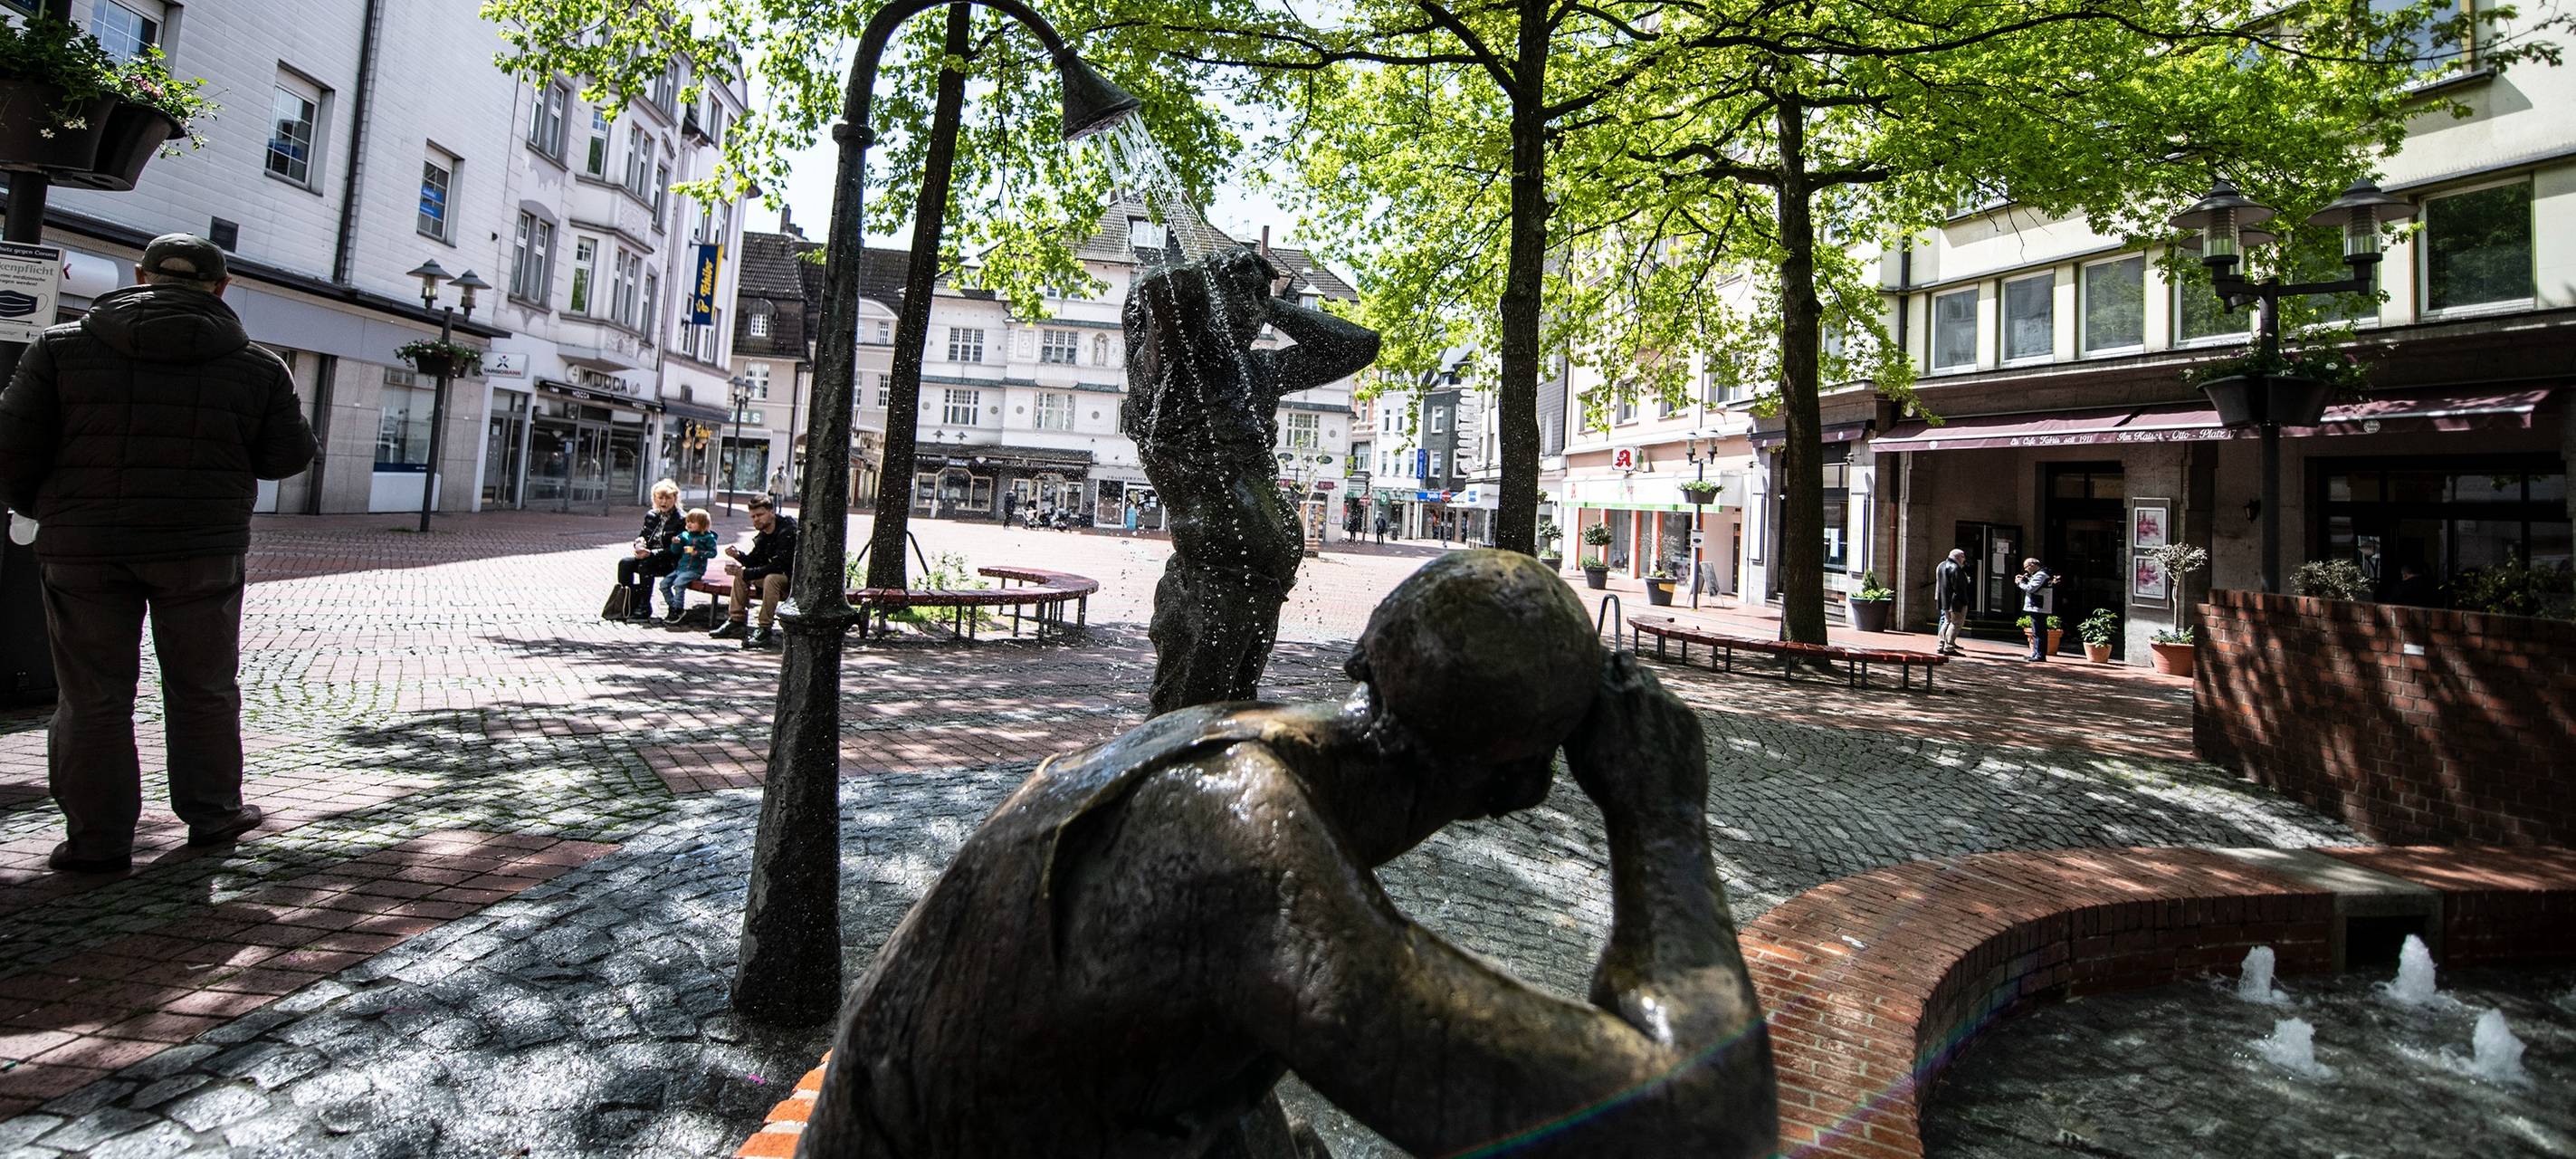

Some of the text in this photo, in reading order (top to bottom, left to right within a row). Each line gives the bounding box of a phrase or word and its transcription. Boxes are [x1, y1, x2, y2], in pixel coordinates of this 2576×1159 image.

[2079, 435, 2094, 443] 1911
[2171, 430, 2190, 440] Otto
[2199, 428, 2226, 439] Platz
